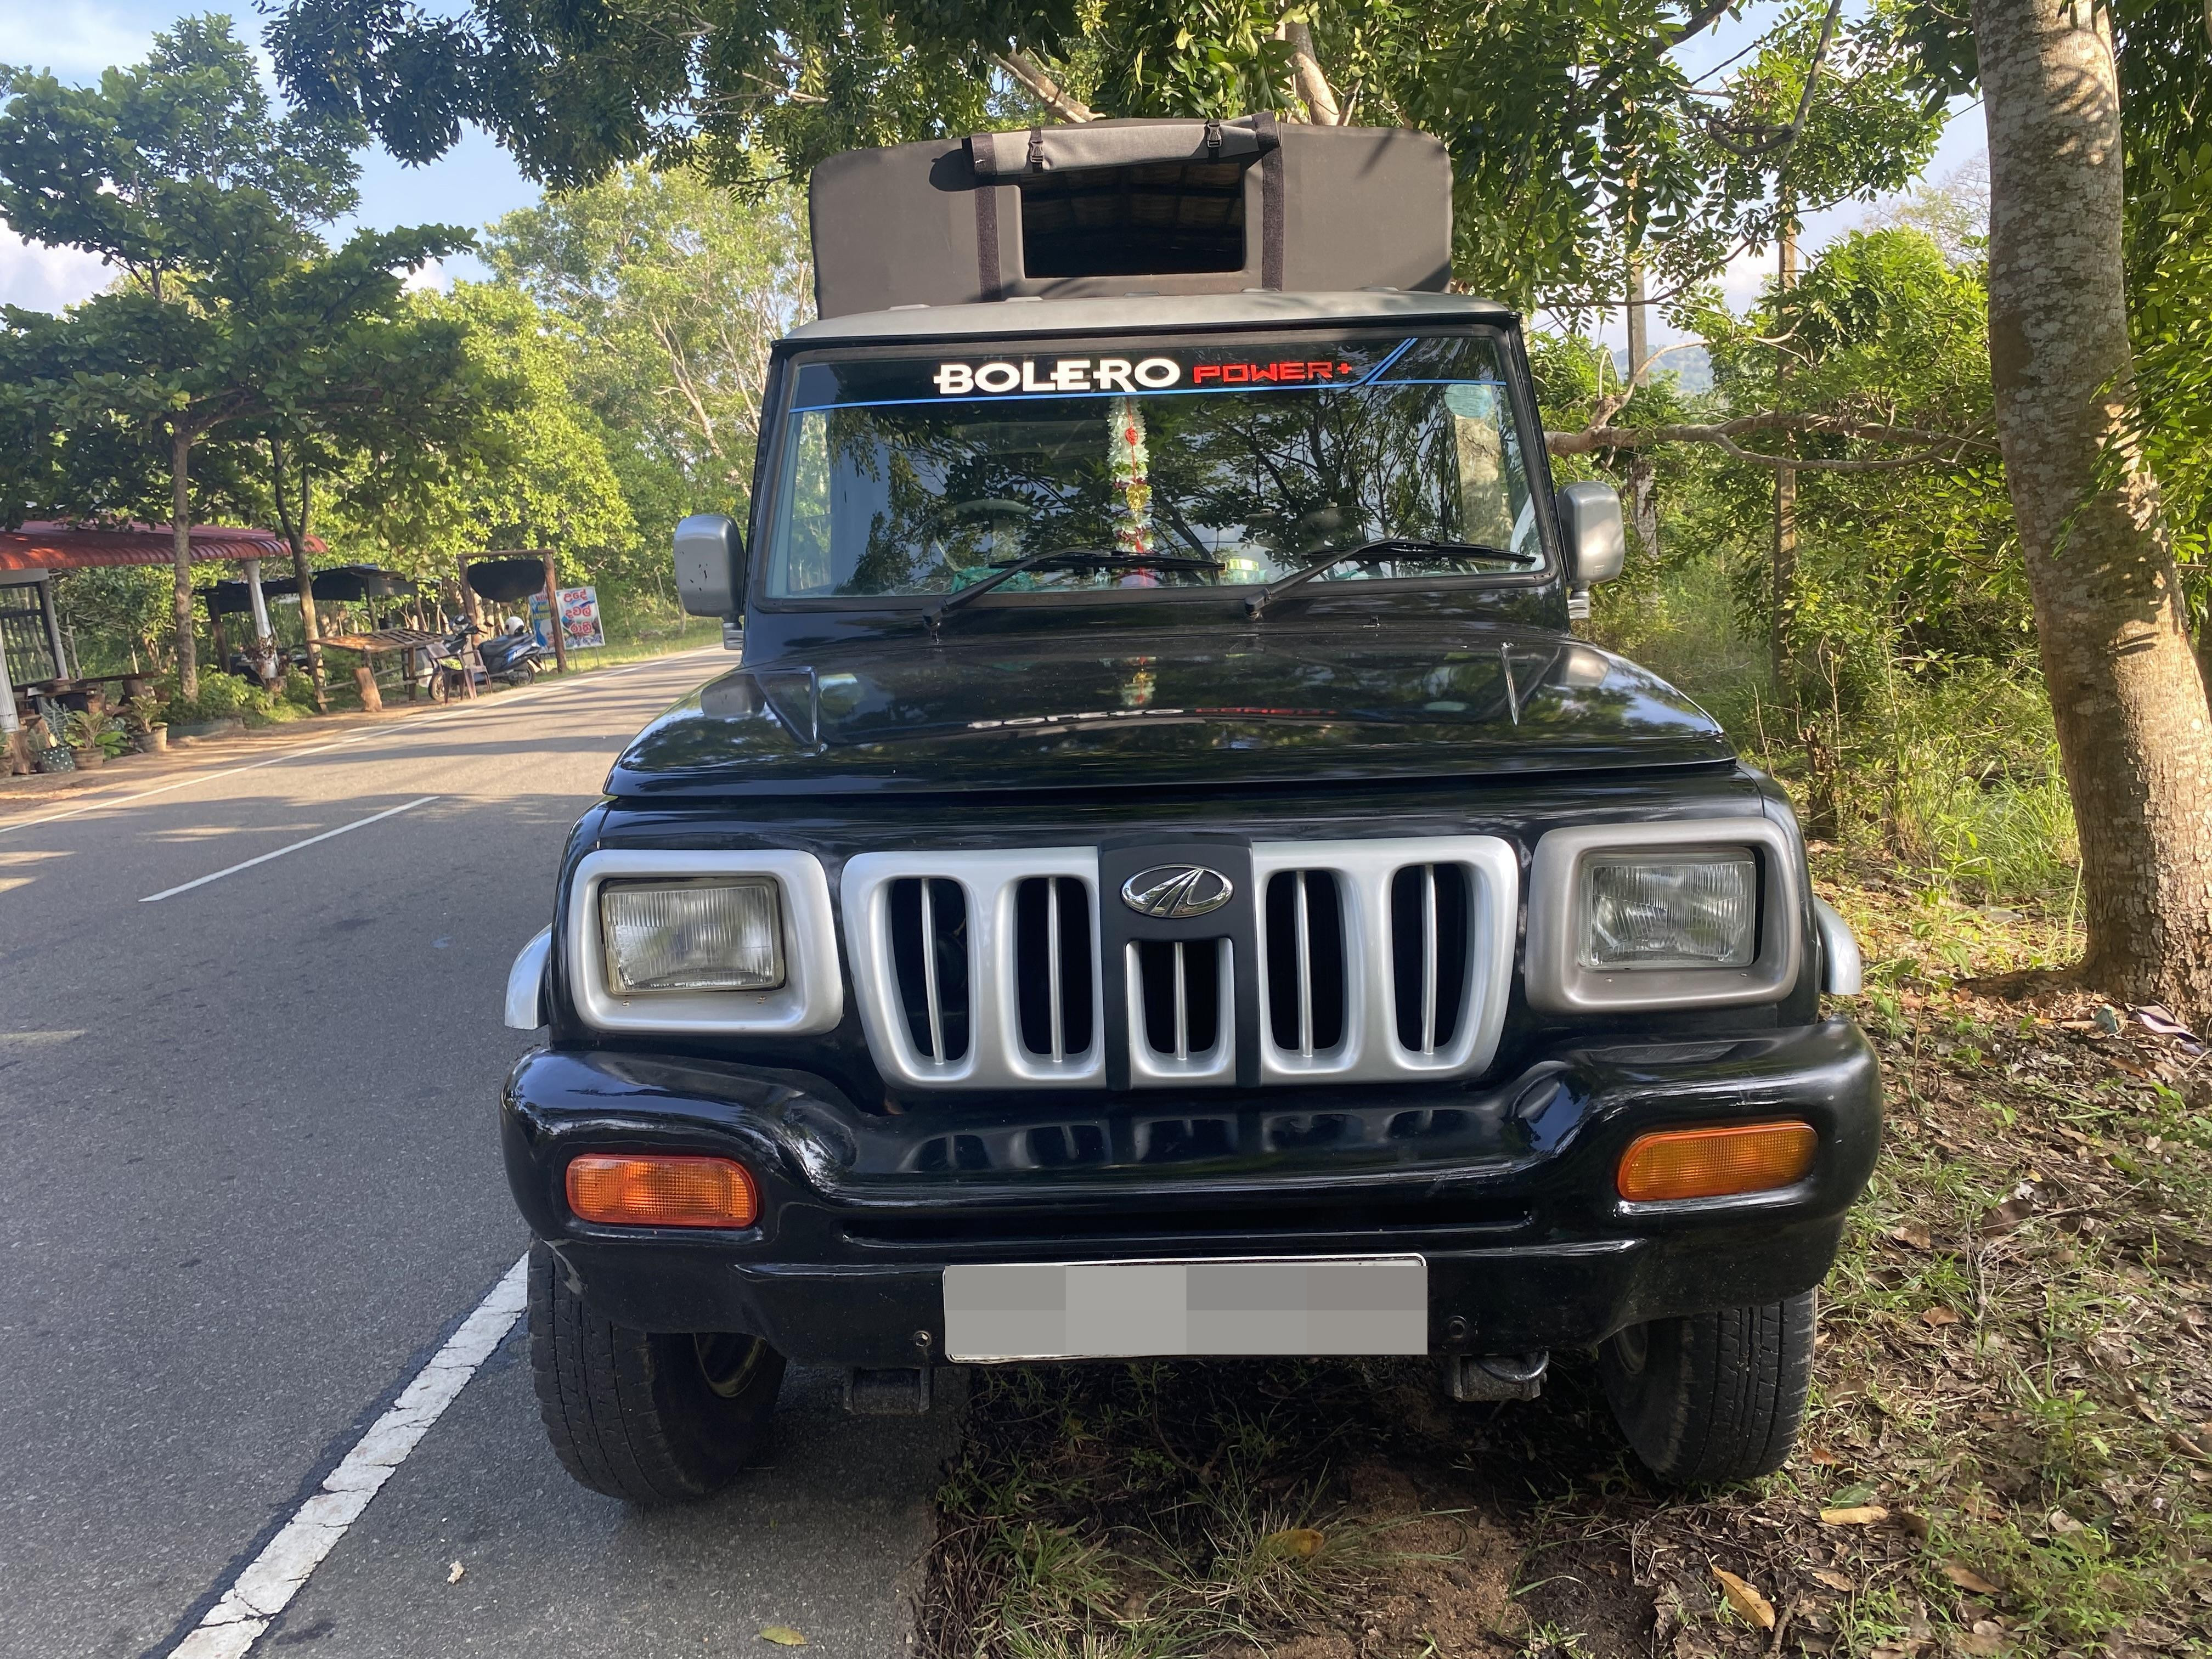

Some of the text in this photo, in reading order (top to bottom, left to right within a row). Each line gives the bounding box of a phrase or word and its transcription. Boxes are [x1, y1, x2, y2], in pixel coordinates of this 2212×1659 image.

[933, 358, 1352, 394] BOLERO POWER+
[563, 589, 588, 602] උදේ
[565, 605, 591, 619] දවල්
